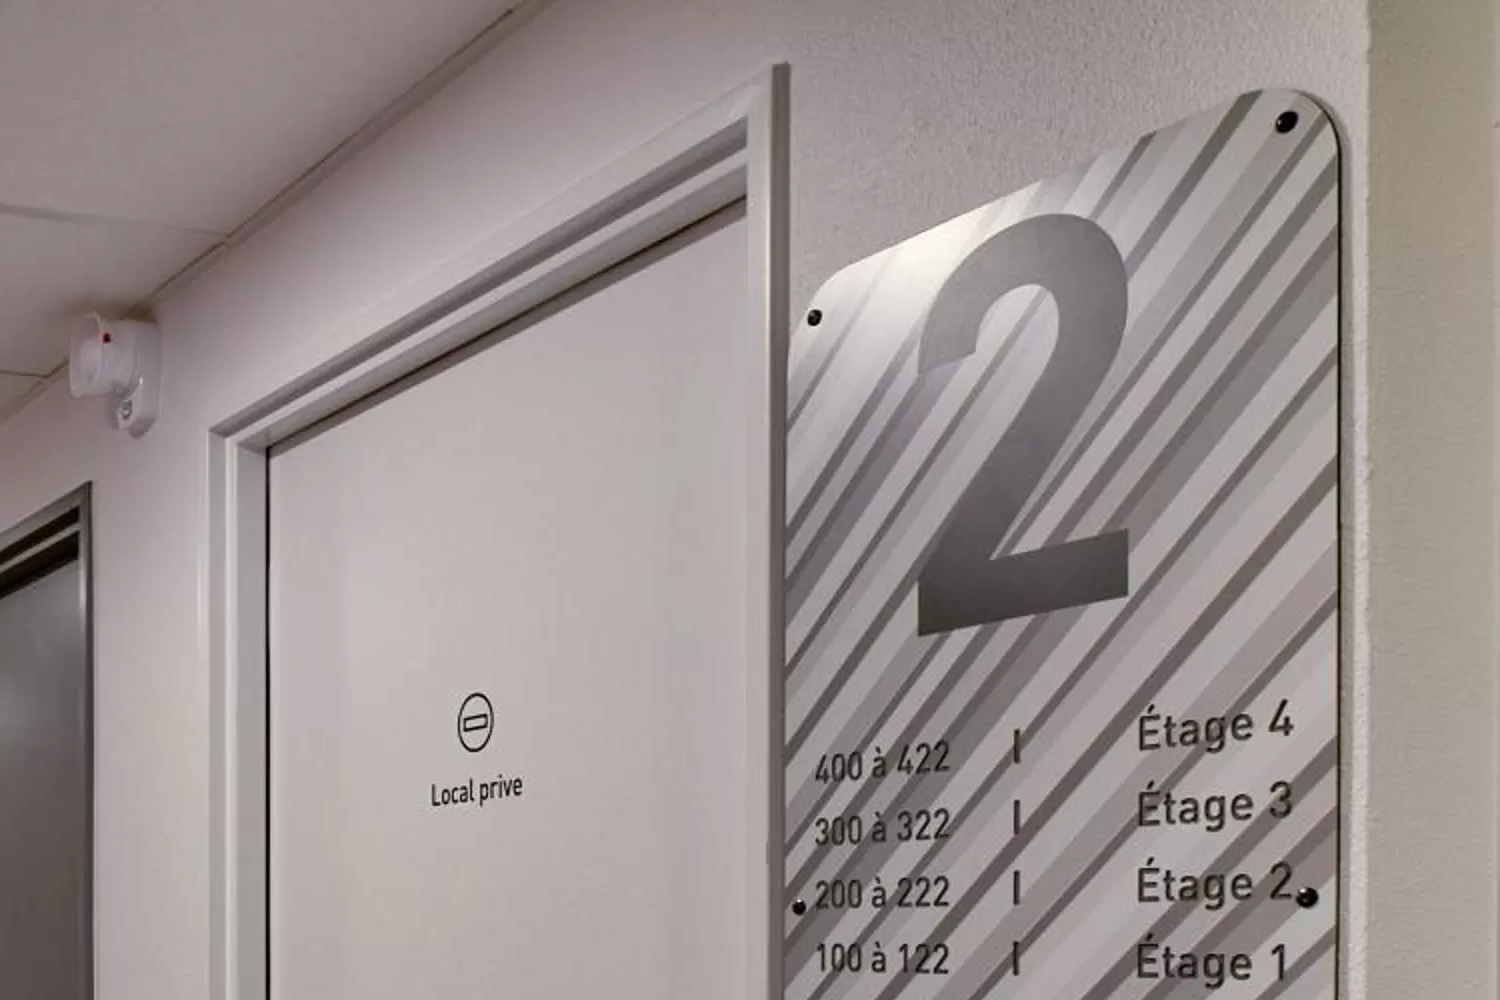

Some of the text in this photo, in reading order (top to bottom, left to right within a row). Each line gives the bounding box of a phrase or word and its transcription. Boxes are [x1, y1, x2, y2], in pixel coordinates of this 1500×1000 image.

[917, 213, 1129, 637] 2
[815, 698, 1295, 786] 400 à 422 Étage 4
[431, 774, 523, 808] Local prive
[815, 780, 1294, 847] 300 à 322 Étage 3
[815, 857, 1294, 910] 200 à 222 Étage 2
[817, 933, 1288, 989] 100 à 122 Étage 1
